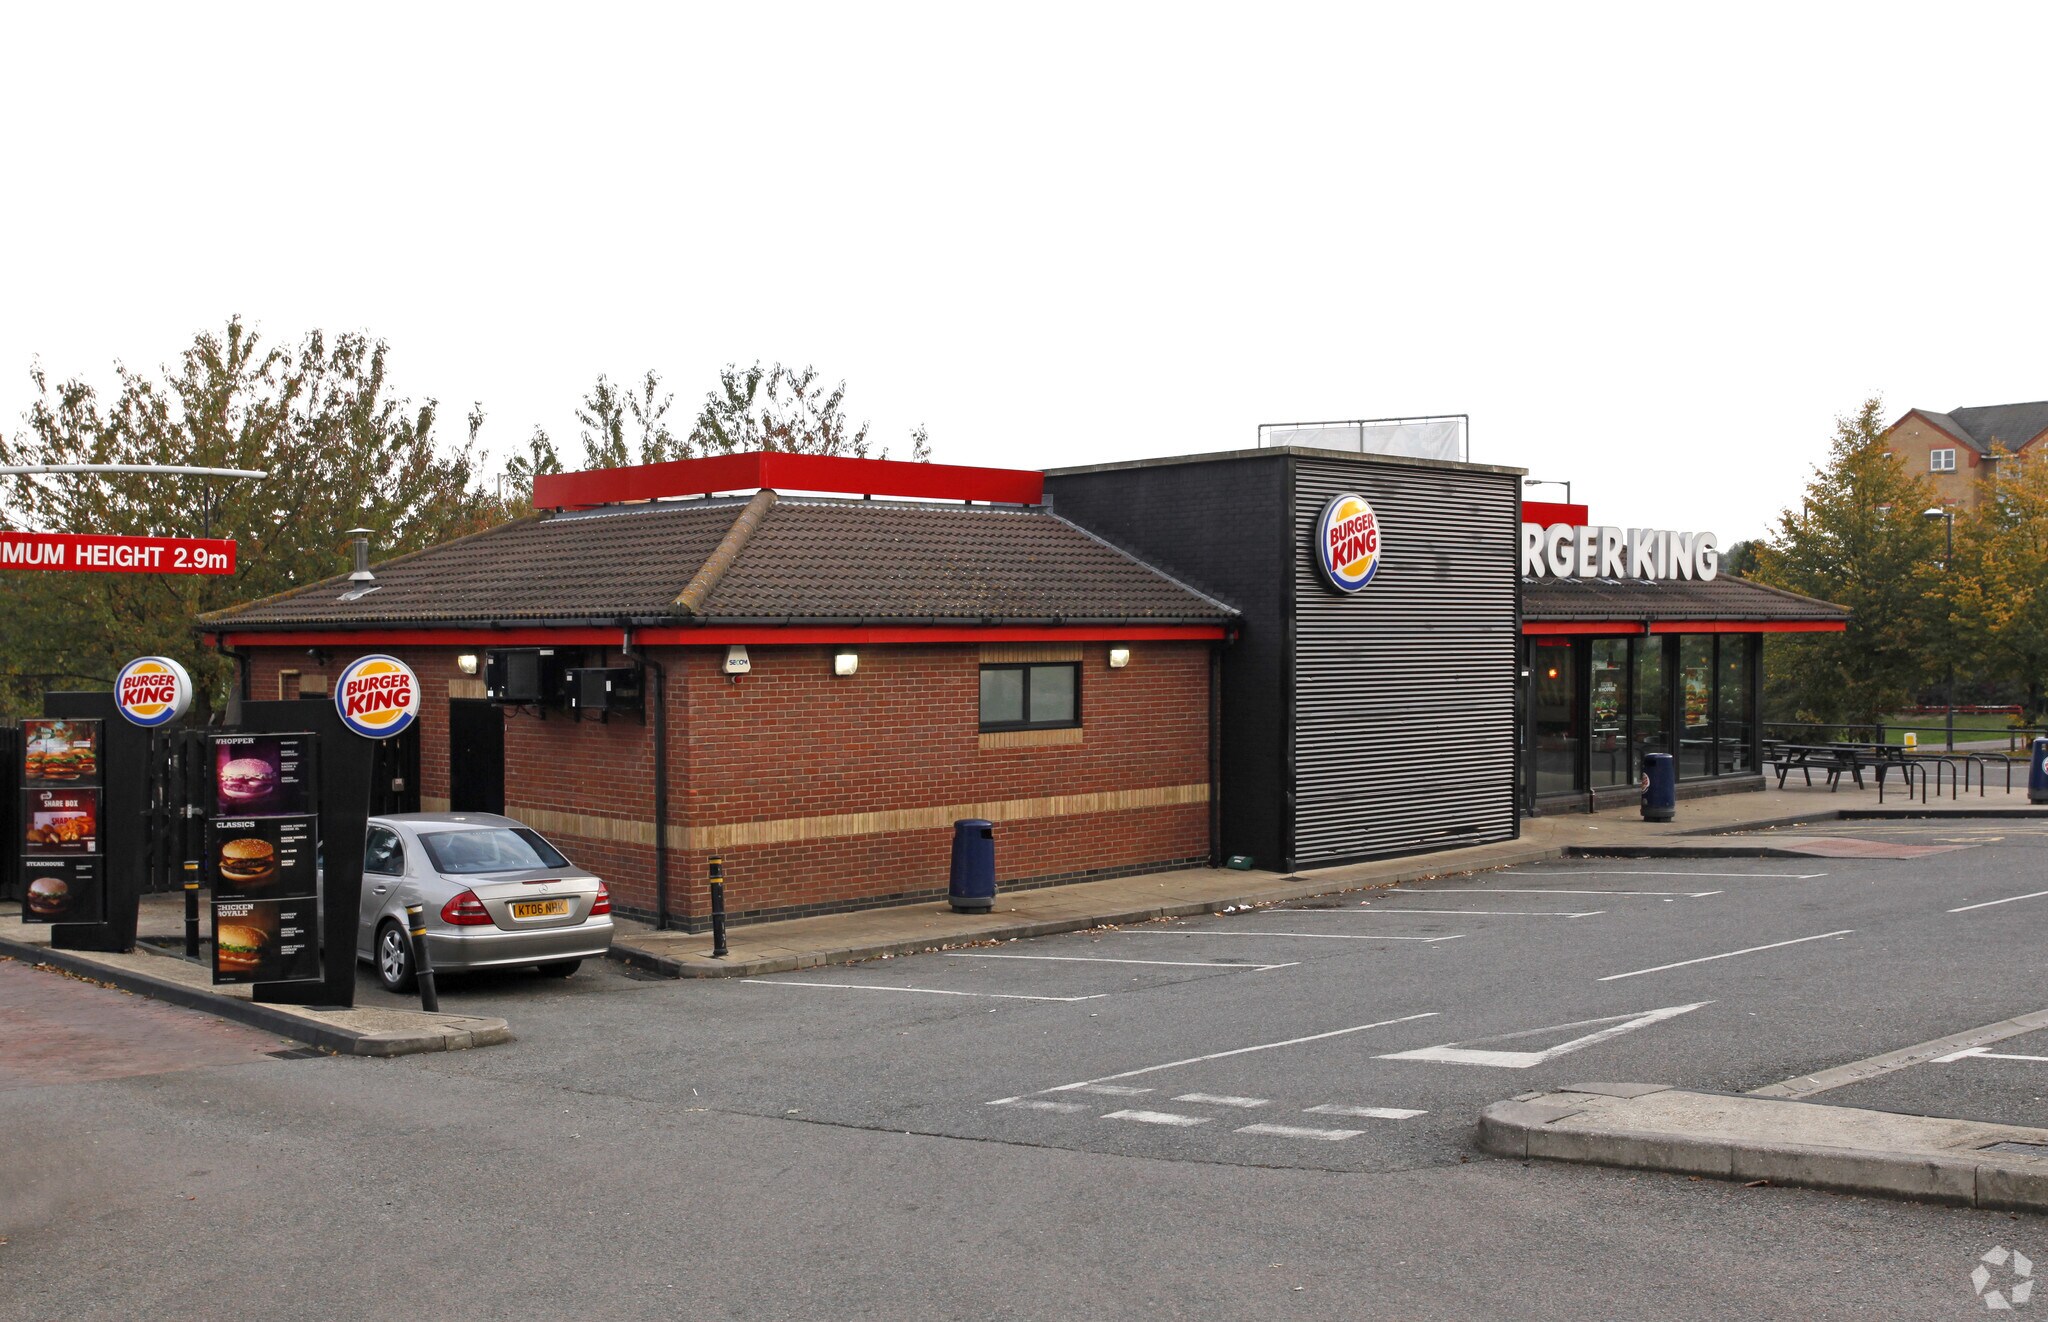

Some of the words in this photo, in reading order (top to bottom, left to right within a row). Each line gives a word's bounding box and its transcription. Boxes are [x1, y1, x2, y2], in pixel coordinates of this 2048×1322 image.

[1330, 513, 1374, 547] BURGER
[0, 541, 64, 564] MUM
[76, 544, 164, 567] HEIGHT
[173, 547, 227, 568] 2.9m
[1332, 529, 1376, 571] KING
[1627, 528, 1718, 581] KING
[123, 674, 175, 689] BURGER
[346, 674, 409, 696] BURGER
[122, 686, 175, 706] KING
[347, 688, 411, 716] KING
[216, 821, 255, 829] CLASSICS
[518, 904, 543, 915] KT06
